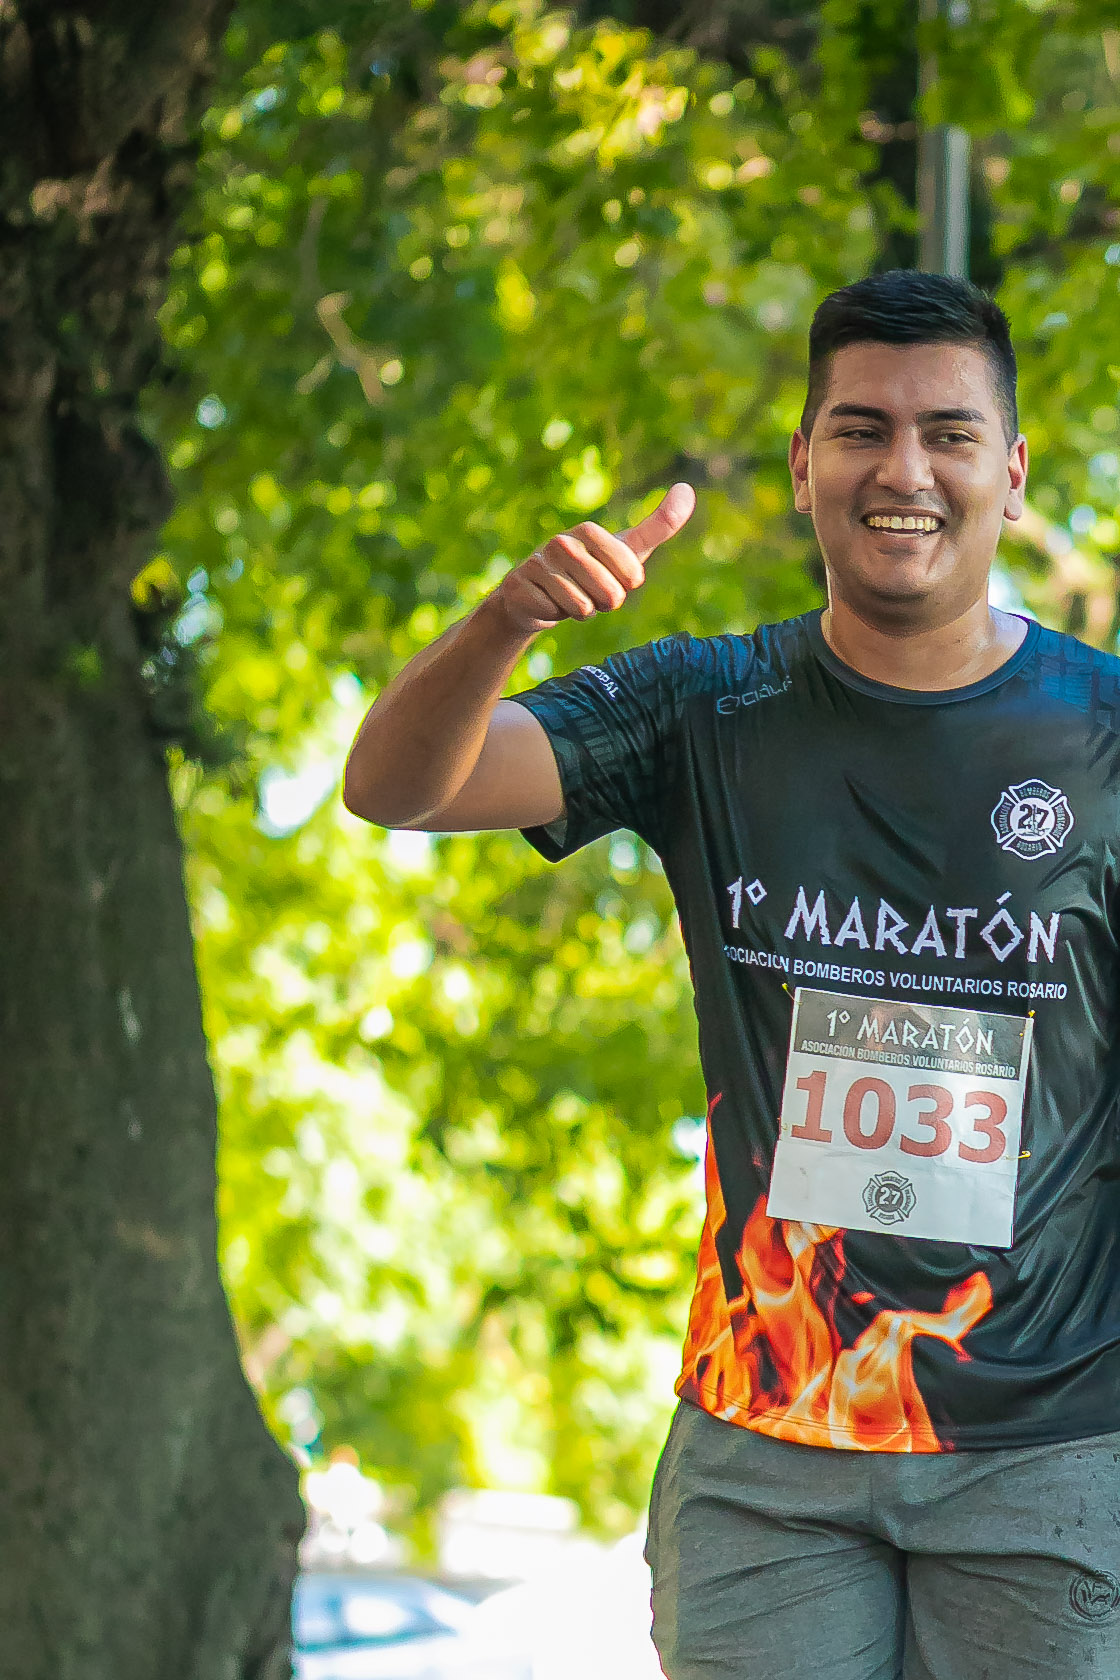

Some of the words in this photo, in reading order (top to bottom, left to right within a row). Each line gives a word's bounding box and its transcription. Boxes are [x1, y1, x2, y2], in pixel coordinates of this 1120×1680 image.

[1017, 803, 1050, 830] 27
[783, 885, 1061, 963] MARATÓN
[793, 959, 885, 987] BOMBEROS
[889, 972, 1003, 996] VOLUNTARIOS
[1007, 982, 1068, 1000] ROSARIO
[856, 1014, 993, 1056] MARATÓN
[857, 1048, 910, 1066] BOMBEROS
[912, 1056, 974, 1073] VOLUNTARIOS
[975, 1063, 1016, 1078] ROSARIO
[791, 1070, 1008, 1164] 1033
[879, 1187, 900, 1205] 27
